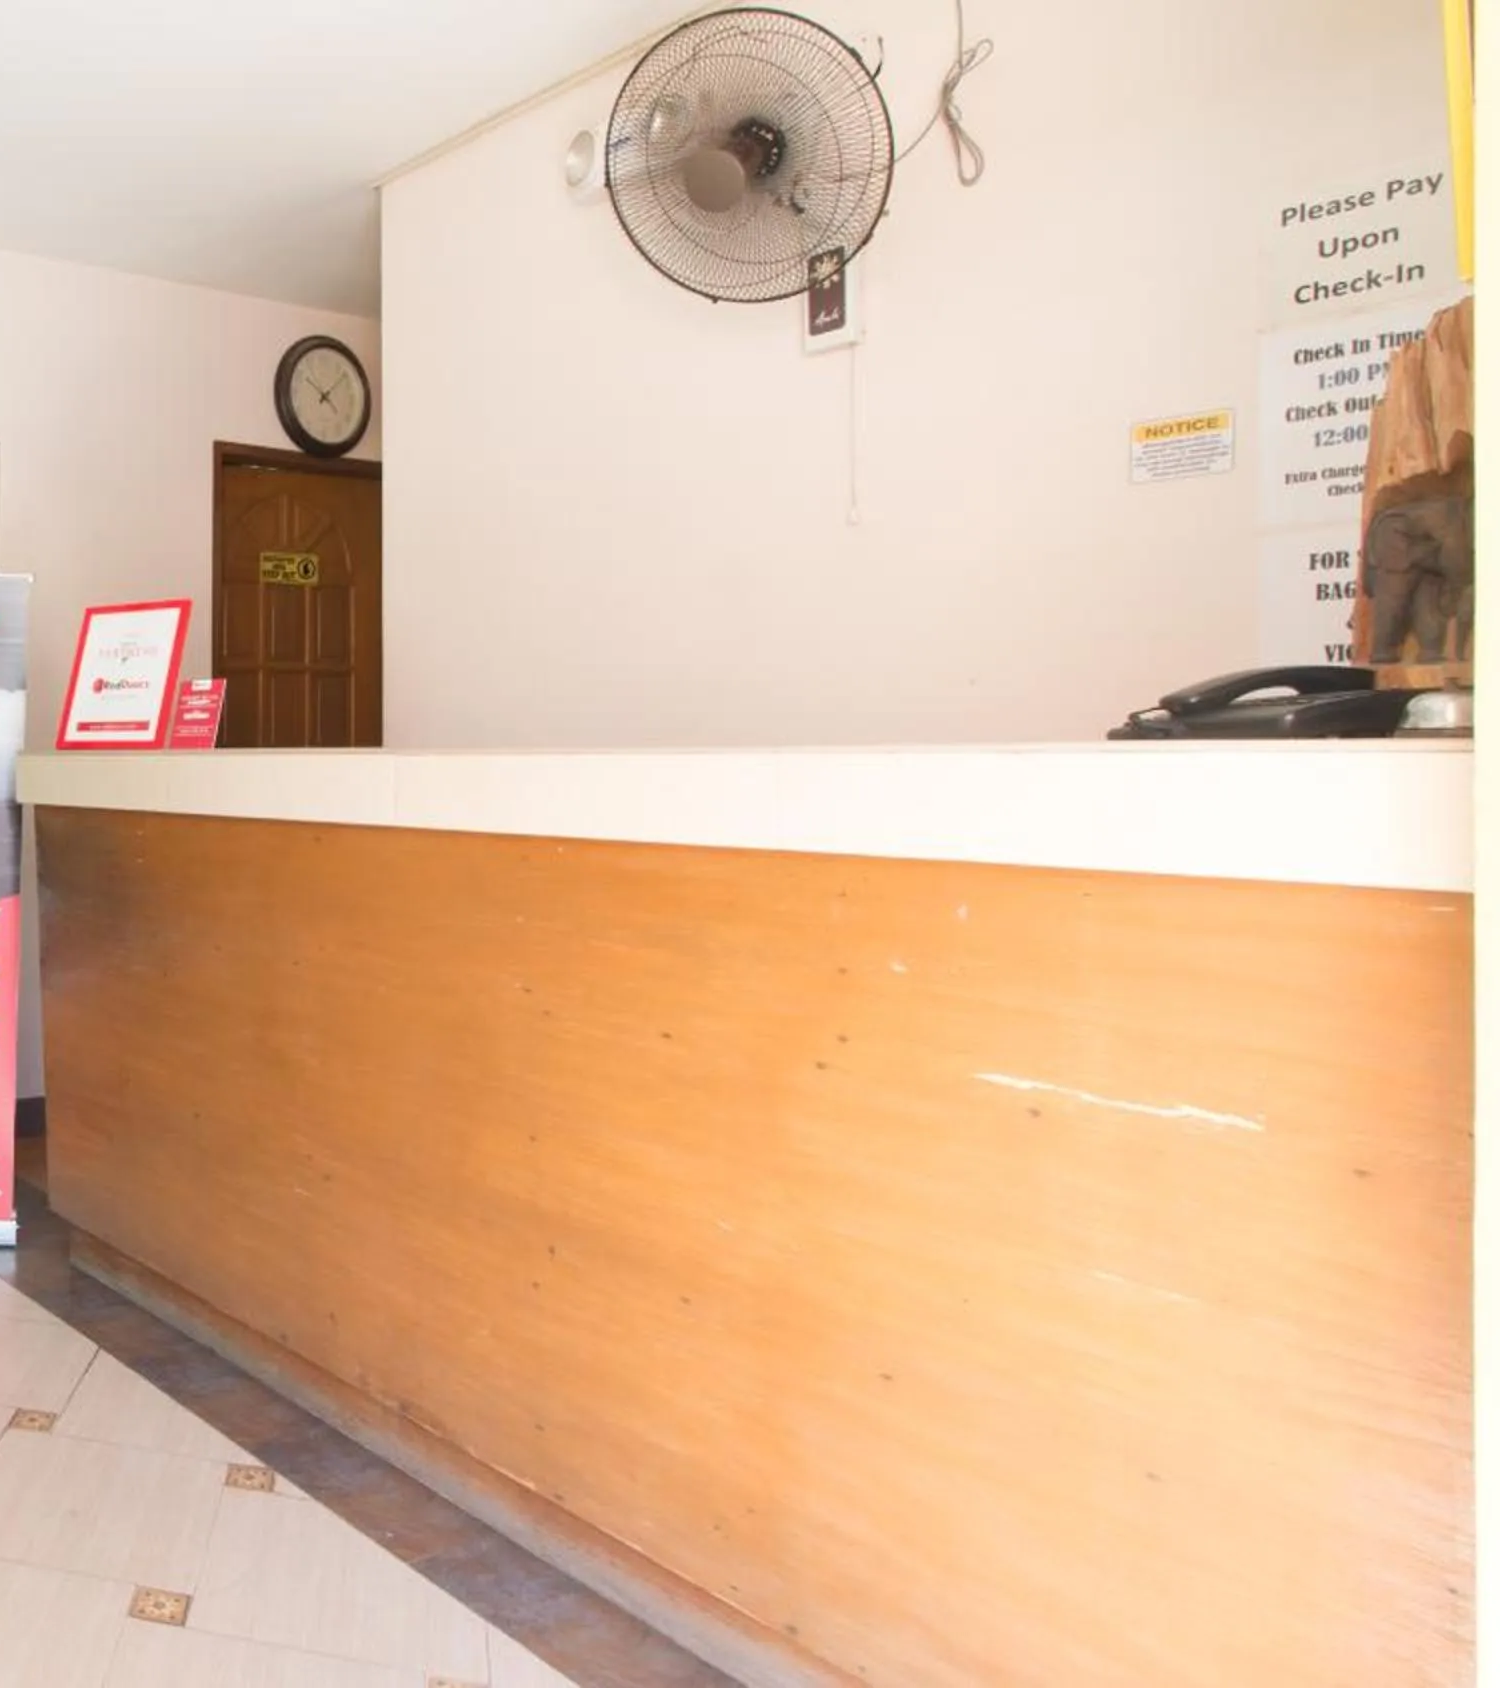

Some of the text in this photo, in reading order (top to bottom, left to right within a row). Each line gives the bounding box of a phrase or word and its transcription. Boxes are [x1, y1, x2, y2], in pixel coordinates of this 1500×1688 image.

[1280, 172, 1444, 227] Please Pay
[1317, 227, 1400, 259] Upon
[1293, 263, 1425, 305] Check-In
[1293, 328, 1425, 365] Check In Time
[1318, 367, 1360, 390] 1:00
[1285, 400, 1338, 423] Check
[1145, 416, 1219, 440] NOTICE
[1313, 424, 1368, 447] 12:00
[1309, 551, 1350, 571] FOR
